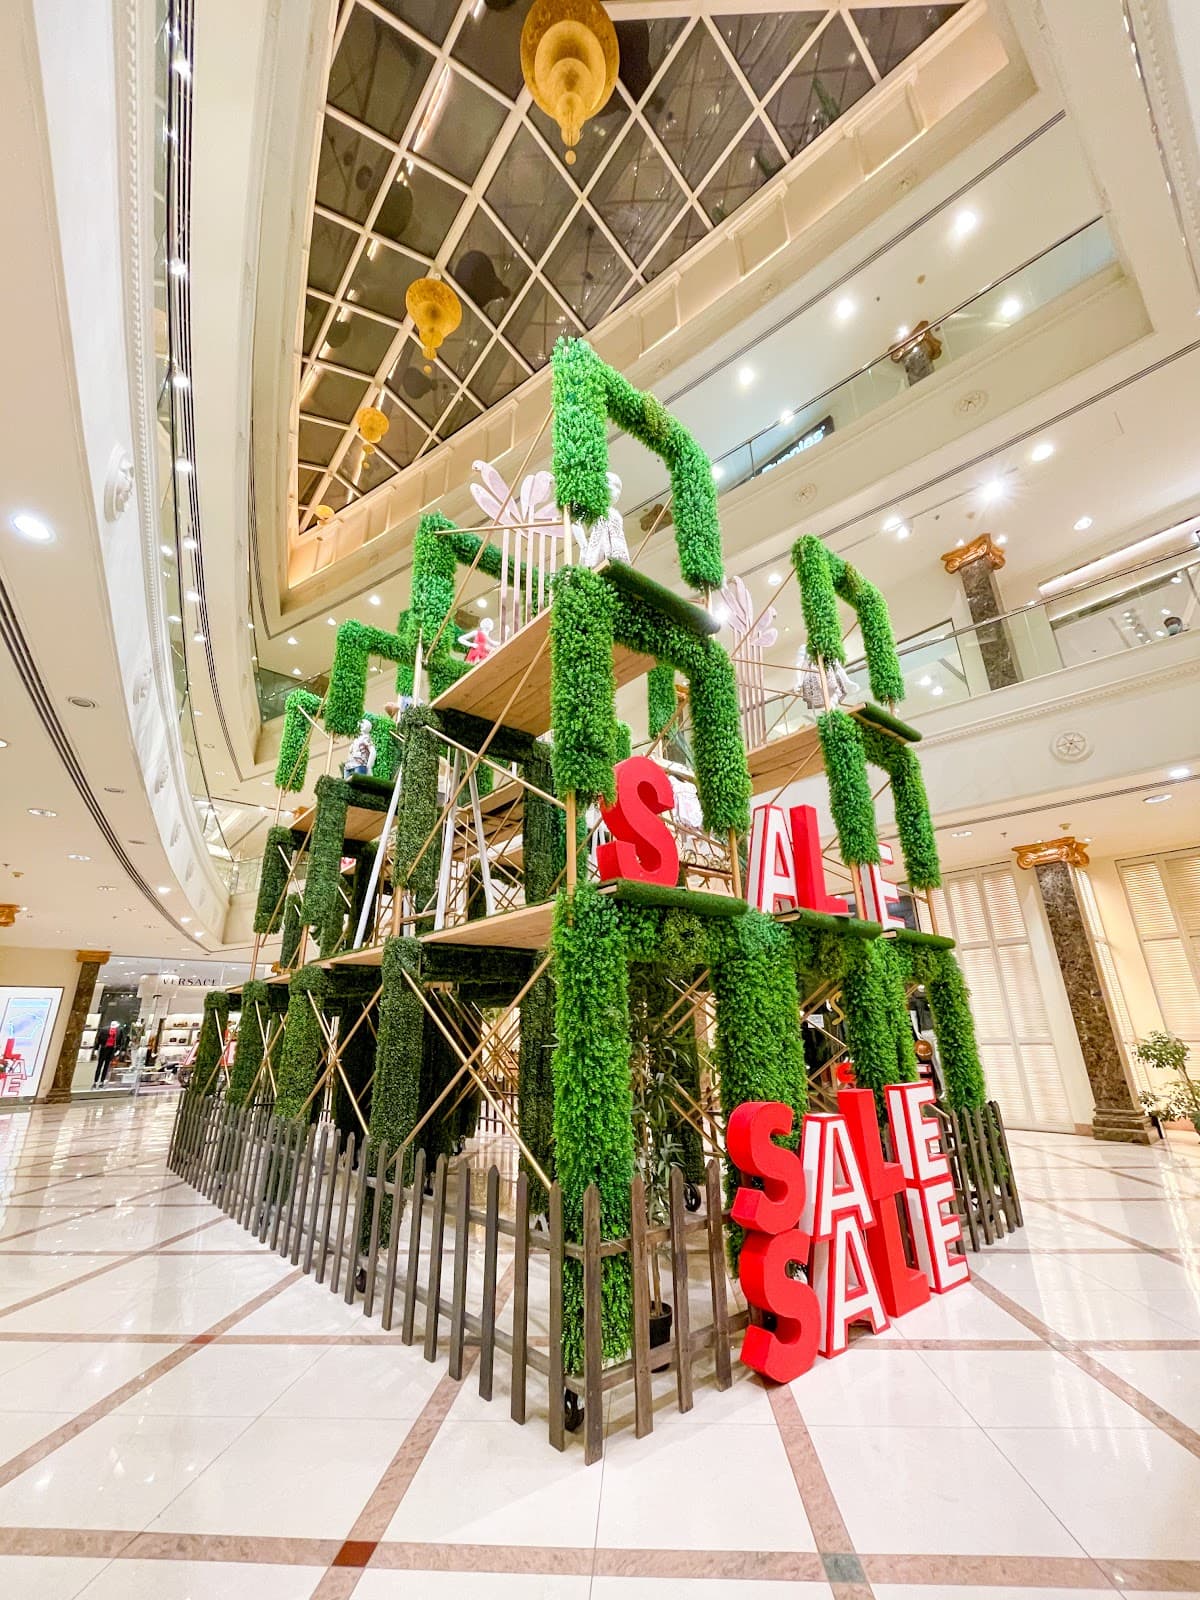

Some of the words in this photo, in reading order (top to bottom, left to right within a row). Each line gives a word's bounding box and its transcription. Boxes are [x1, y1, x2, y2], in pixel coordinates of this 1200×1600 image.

[597, 756, 905, 929] SALE
[727, 1080, 954, 1243] SALE
[739, 1178, 971, 1384] SALE
